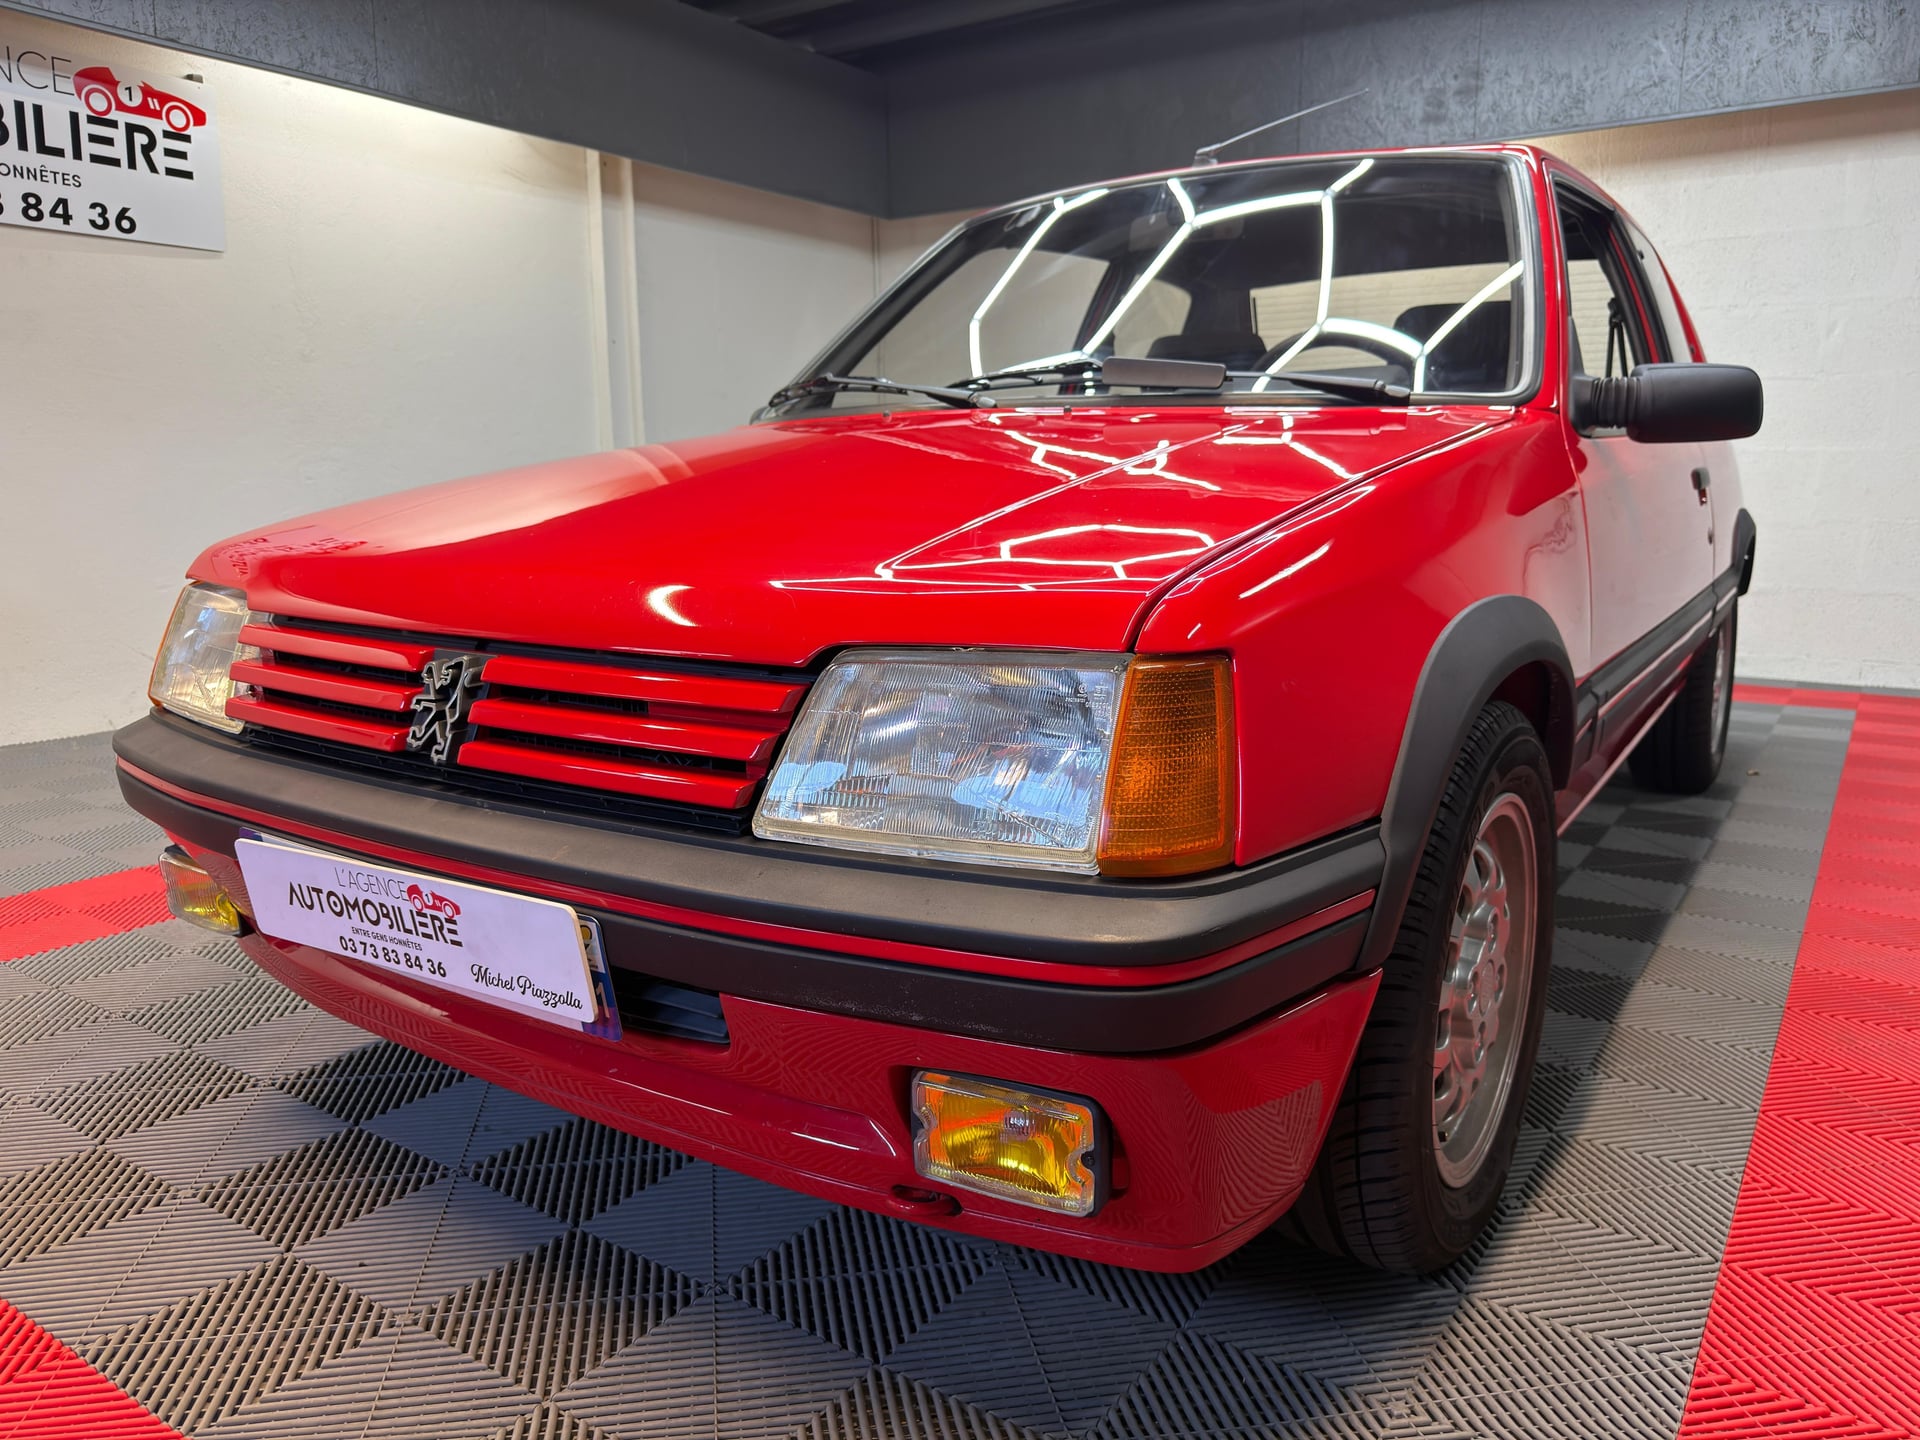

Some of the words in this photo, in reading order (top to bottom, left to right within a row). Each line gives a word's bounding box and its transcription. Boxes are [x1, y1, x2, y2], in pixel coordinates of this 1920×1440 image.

[124, 86, 133, 102] 1
[21, 192, 73, 226] 84
[88, 202, 137, 234] 36
[335, 867, 409, 902] L'AGENCE
[289, 881, 463, 947] AUTOMOBILIERE
[339, 935, 358, 954] 03
[359, 941, 379, 959] 73
[382, 946, 401, 965] 83
[404, 952, 423, 971] 84
[426, 958, 447, 978] 36
[351, 926, 372, 938] ENTRE
[371, 931, 387, 943] GENS
[389, 936, 423, 951] HONNÊTES
[470, 963, 515, 991] Michel
[516, 975, 583, 1009] Piazzolla
